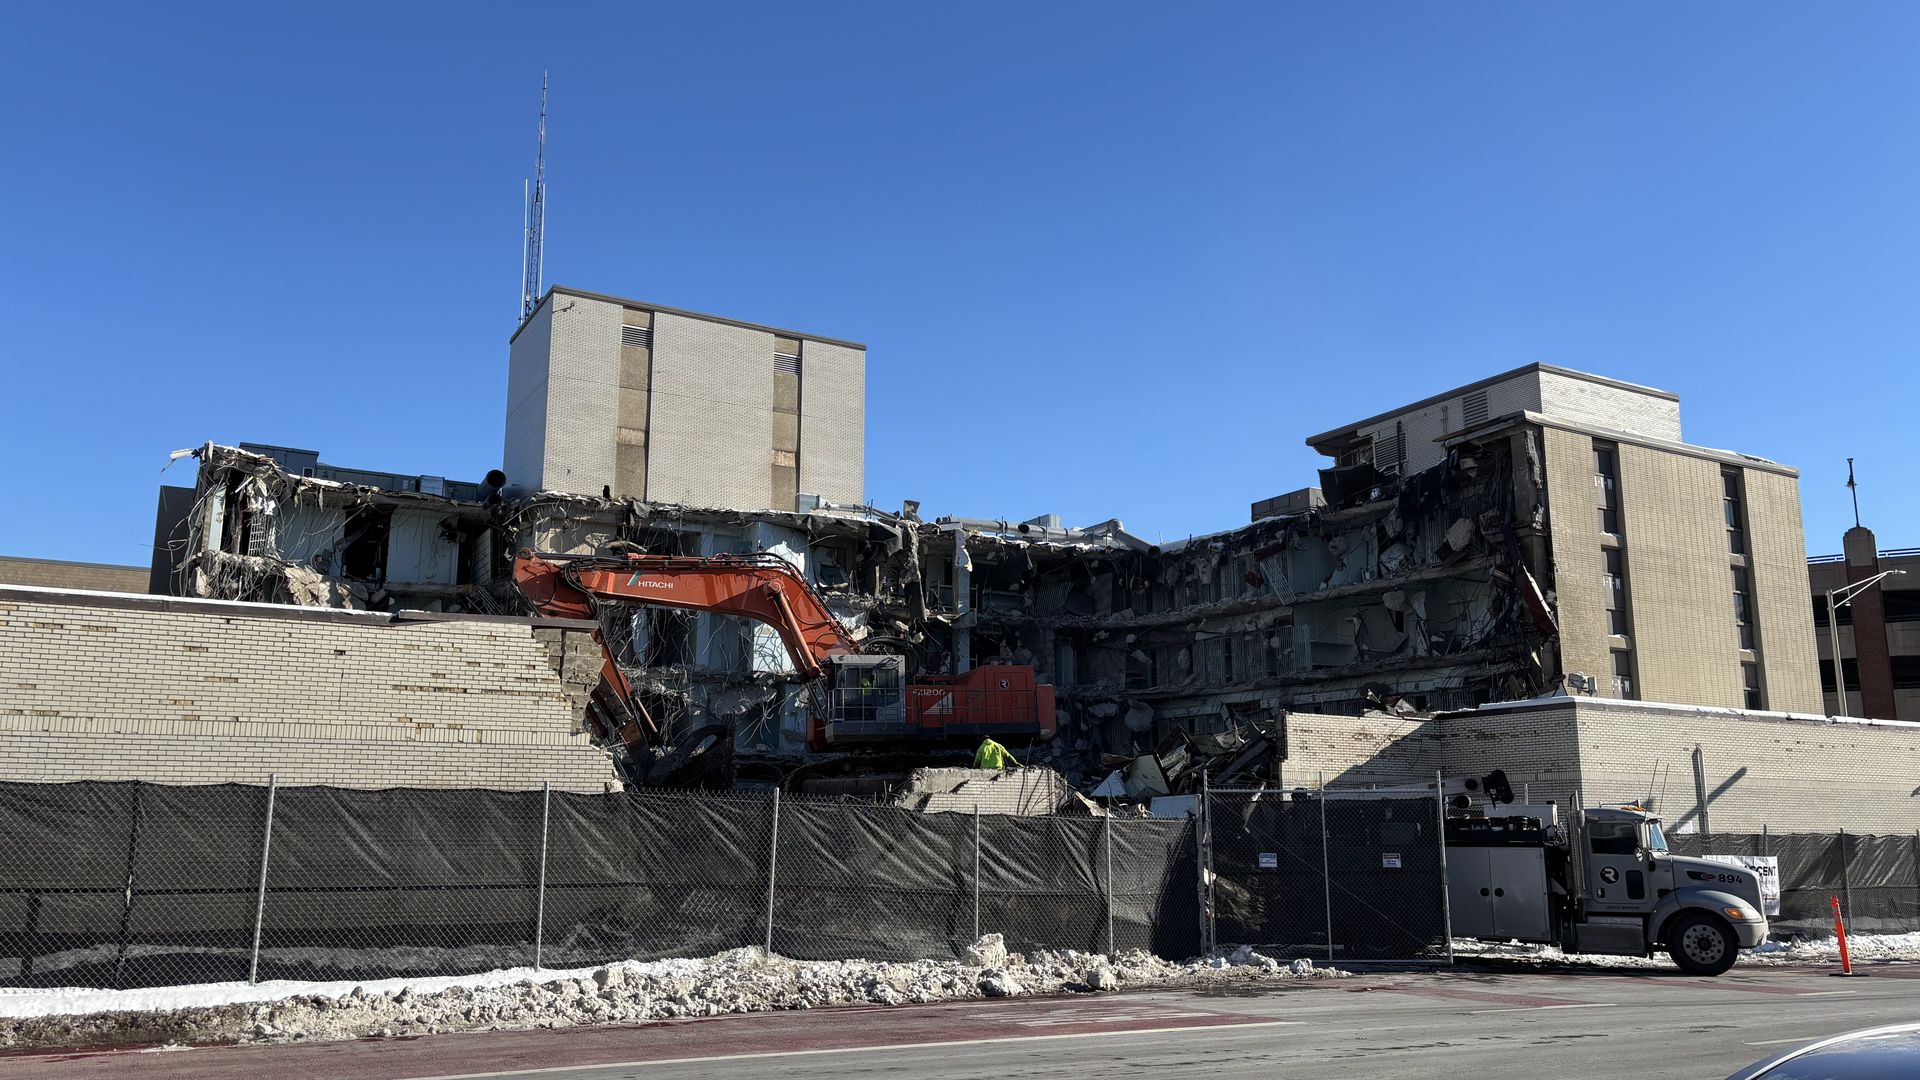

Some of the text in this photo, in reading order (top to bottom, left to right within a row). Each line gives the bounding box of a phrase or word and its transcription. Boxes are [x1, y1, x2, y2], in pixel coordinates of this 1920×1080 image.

[638, 581, 674, 589] HITACHI
[1744, 866, 1776, 877] CENT
[1718, 873, 1743, 885] 894
